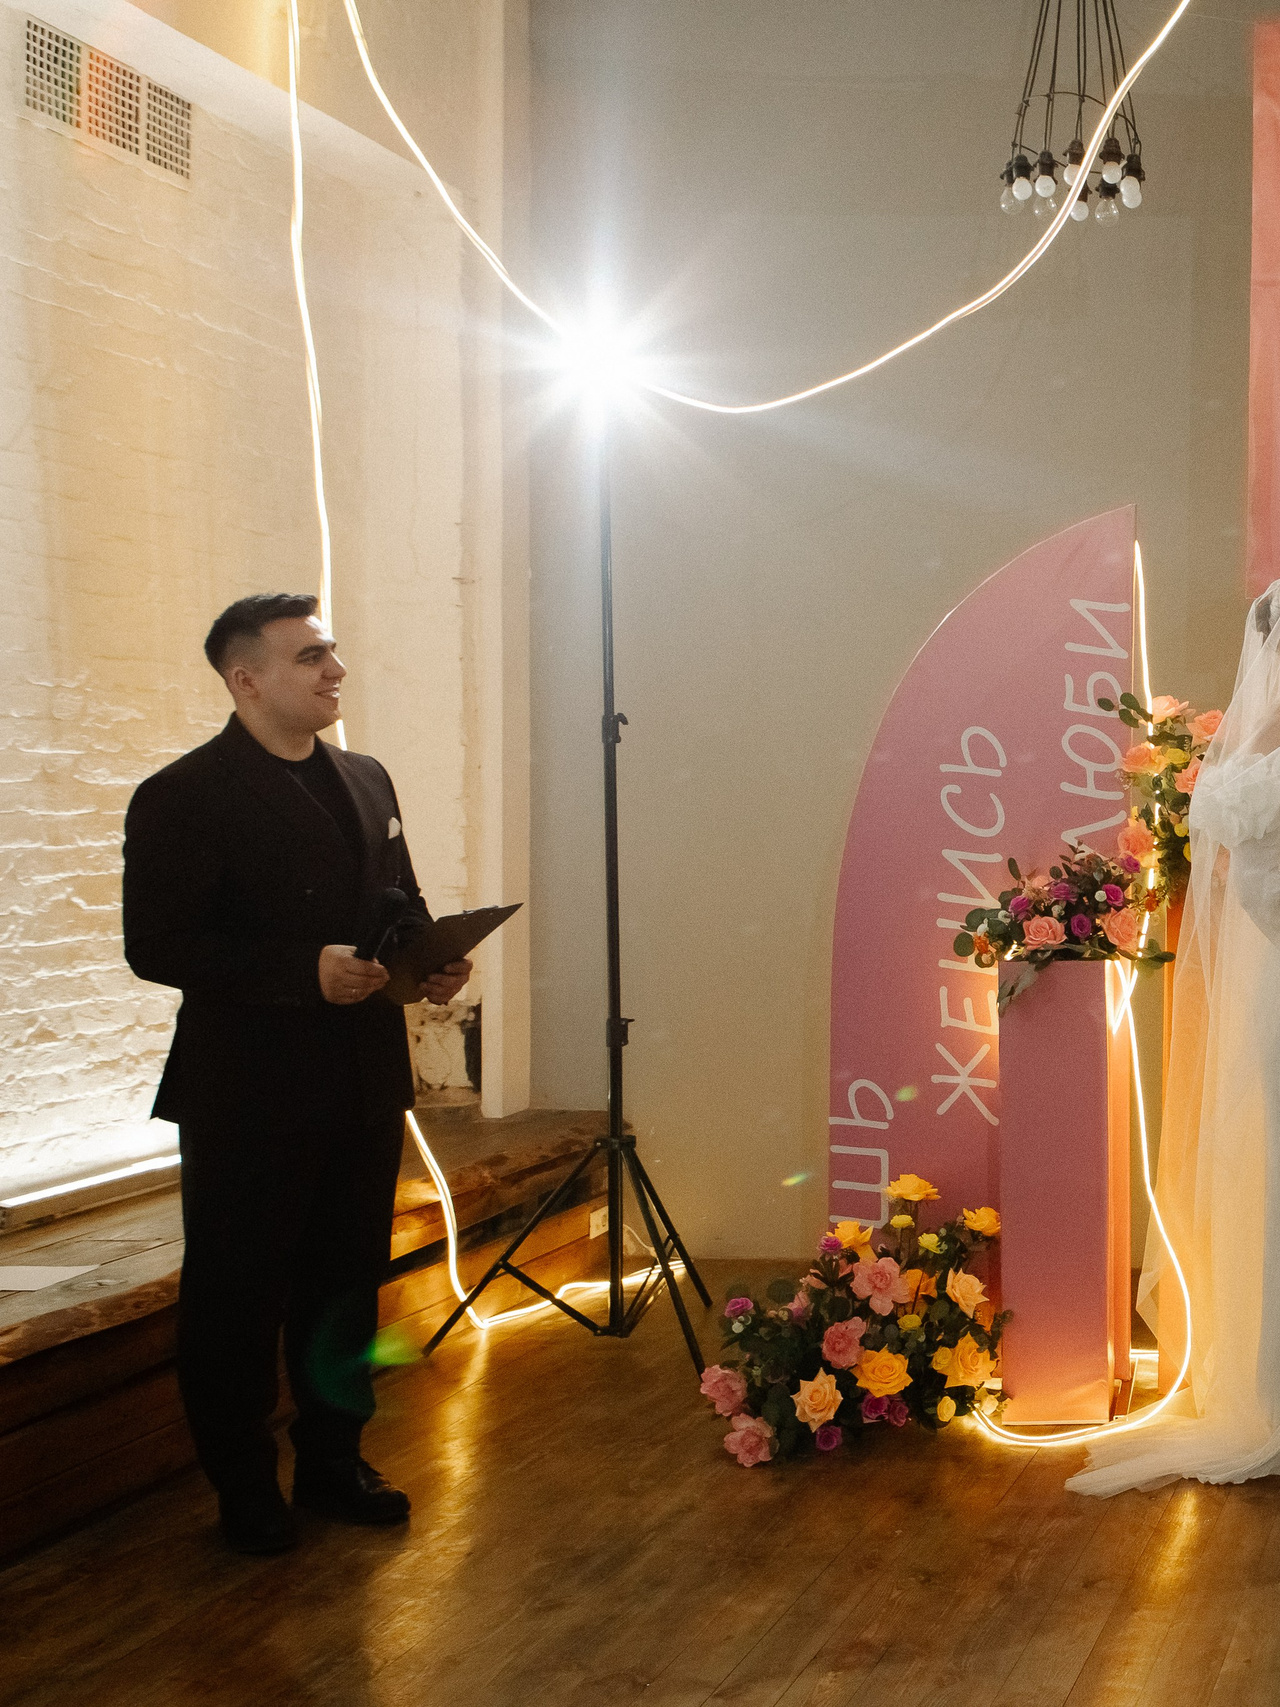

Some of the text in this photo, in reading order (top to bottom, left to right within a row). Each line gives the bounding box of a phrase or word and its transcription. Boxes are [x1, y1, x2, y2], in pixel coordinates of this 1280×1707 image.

[1060, 598, 1132, 870] ЛЮБИ
[930, 724, 1008, 1126] ЖЕНИСЬ
[828, 1078, 895, 1230] ШЬ
